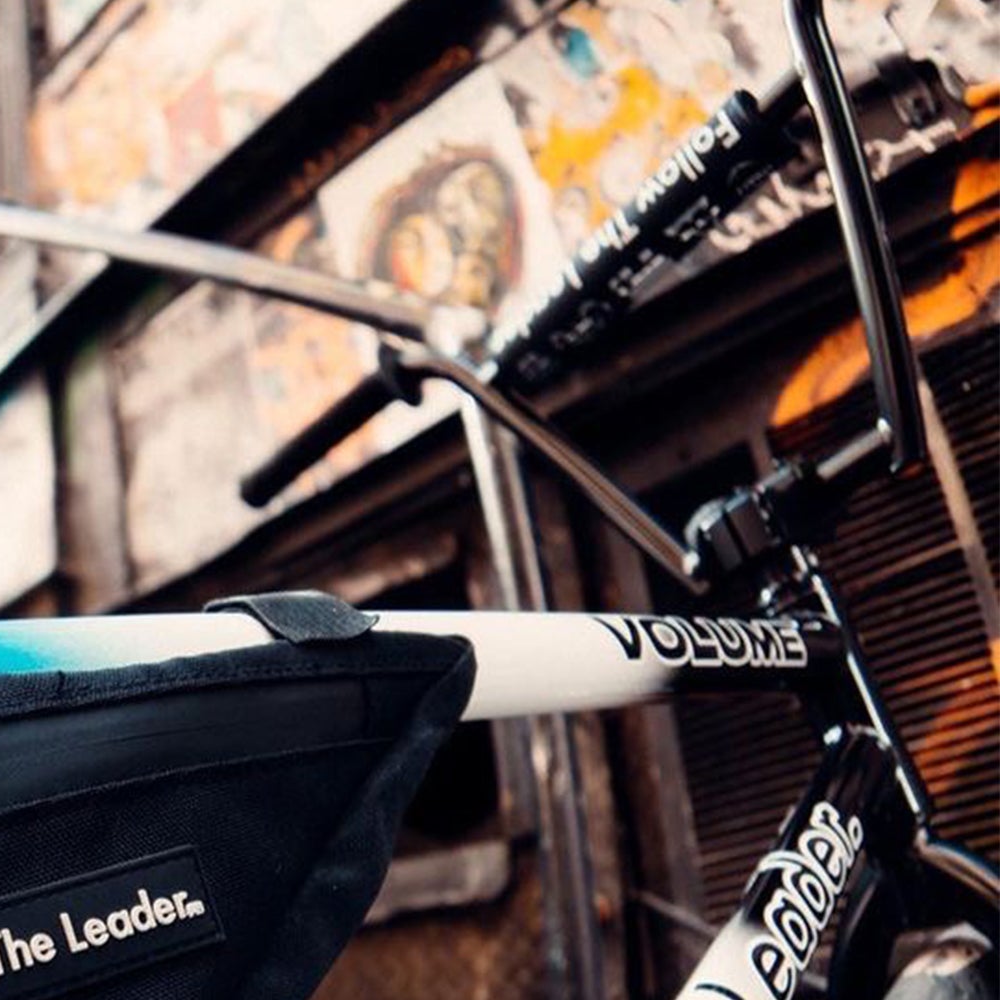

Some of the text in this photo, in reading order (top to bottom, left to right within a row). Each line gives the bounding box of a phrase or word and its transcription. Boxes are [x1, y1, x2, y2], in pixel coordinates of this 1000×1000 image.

[635, 110, 741, 213] Follow
[593, 614, 808, 667] VOLUME
[59, 888, 190, 954] Leader
